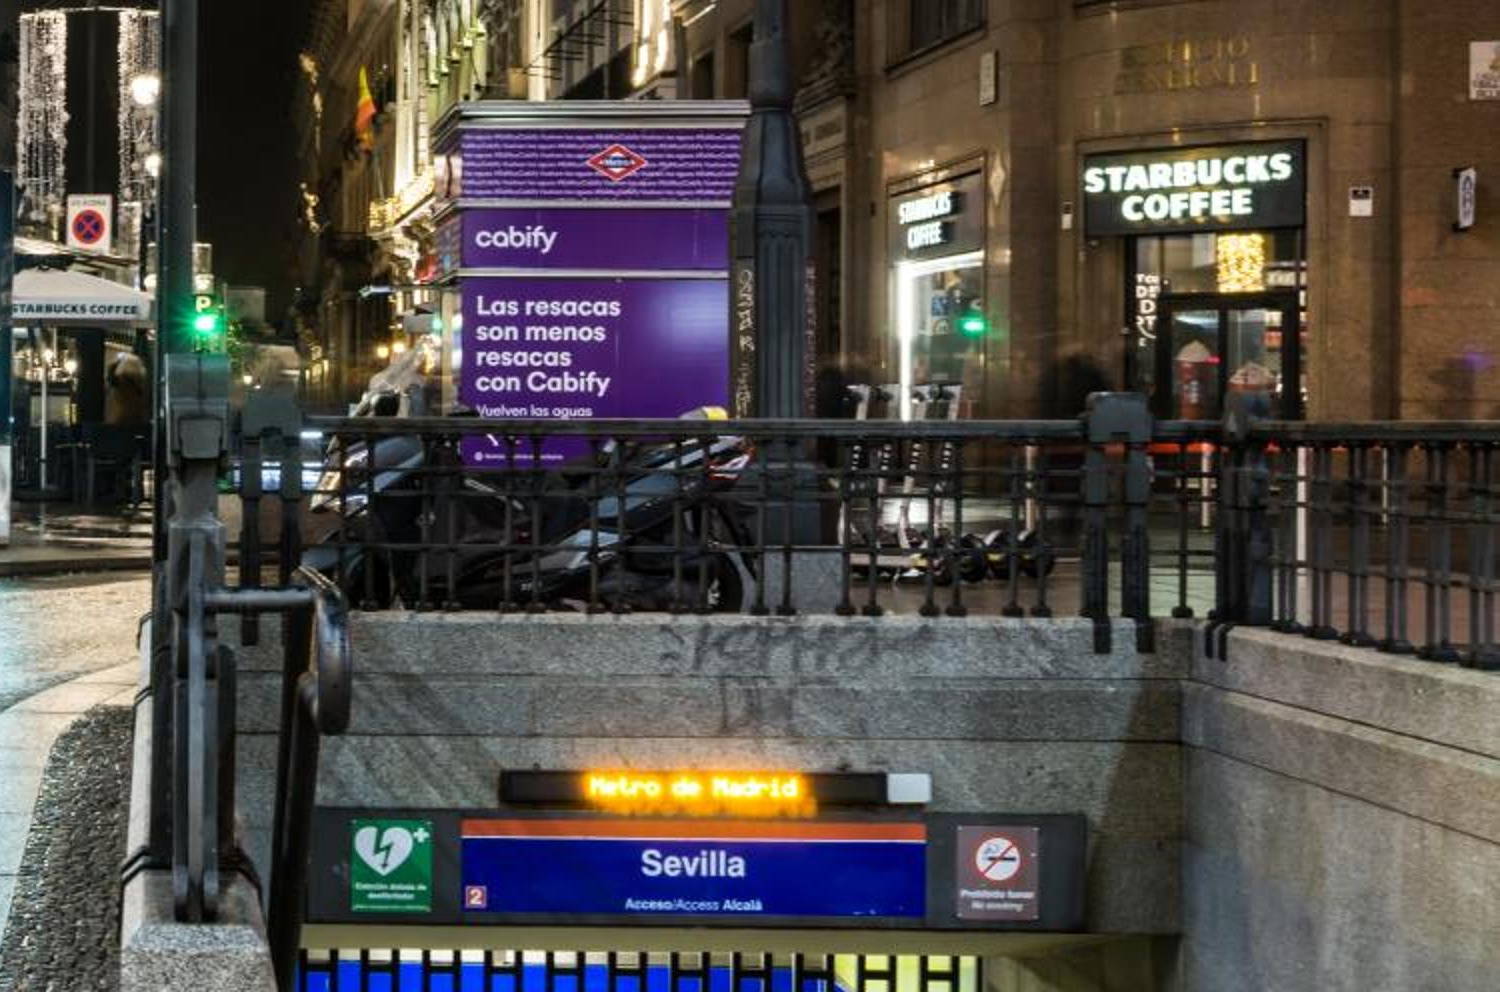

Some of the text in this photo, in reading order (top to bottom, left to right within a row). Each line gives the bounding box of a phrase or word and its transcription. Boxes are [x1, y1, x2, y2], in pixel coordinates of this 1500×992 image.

[1084, 153, 1292, 193] STARBUCKS
[1121, 188, 1253, 222] COFFEE
[475, 225, 558, 253] cabify
[12, 303, 138, 315] STARBUCKS COFFEE
[476, 295, 621, 317] Las resacas
[476, 325, 606, 342] son menos
[476, 350, 572, 368] resacas
[476, 371, 611, 397] con Cabify
[476, 404, 593, 419] Vuelven las aguas
[590, 776, 799, 798] Metro de Madrid
[641, 849, 746, 878] Sevilla
[469, 889, 483, 905] 2
[722, 899, 763, 911] Alcalá
